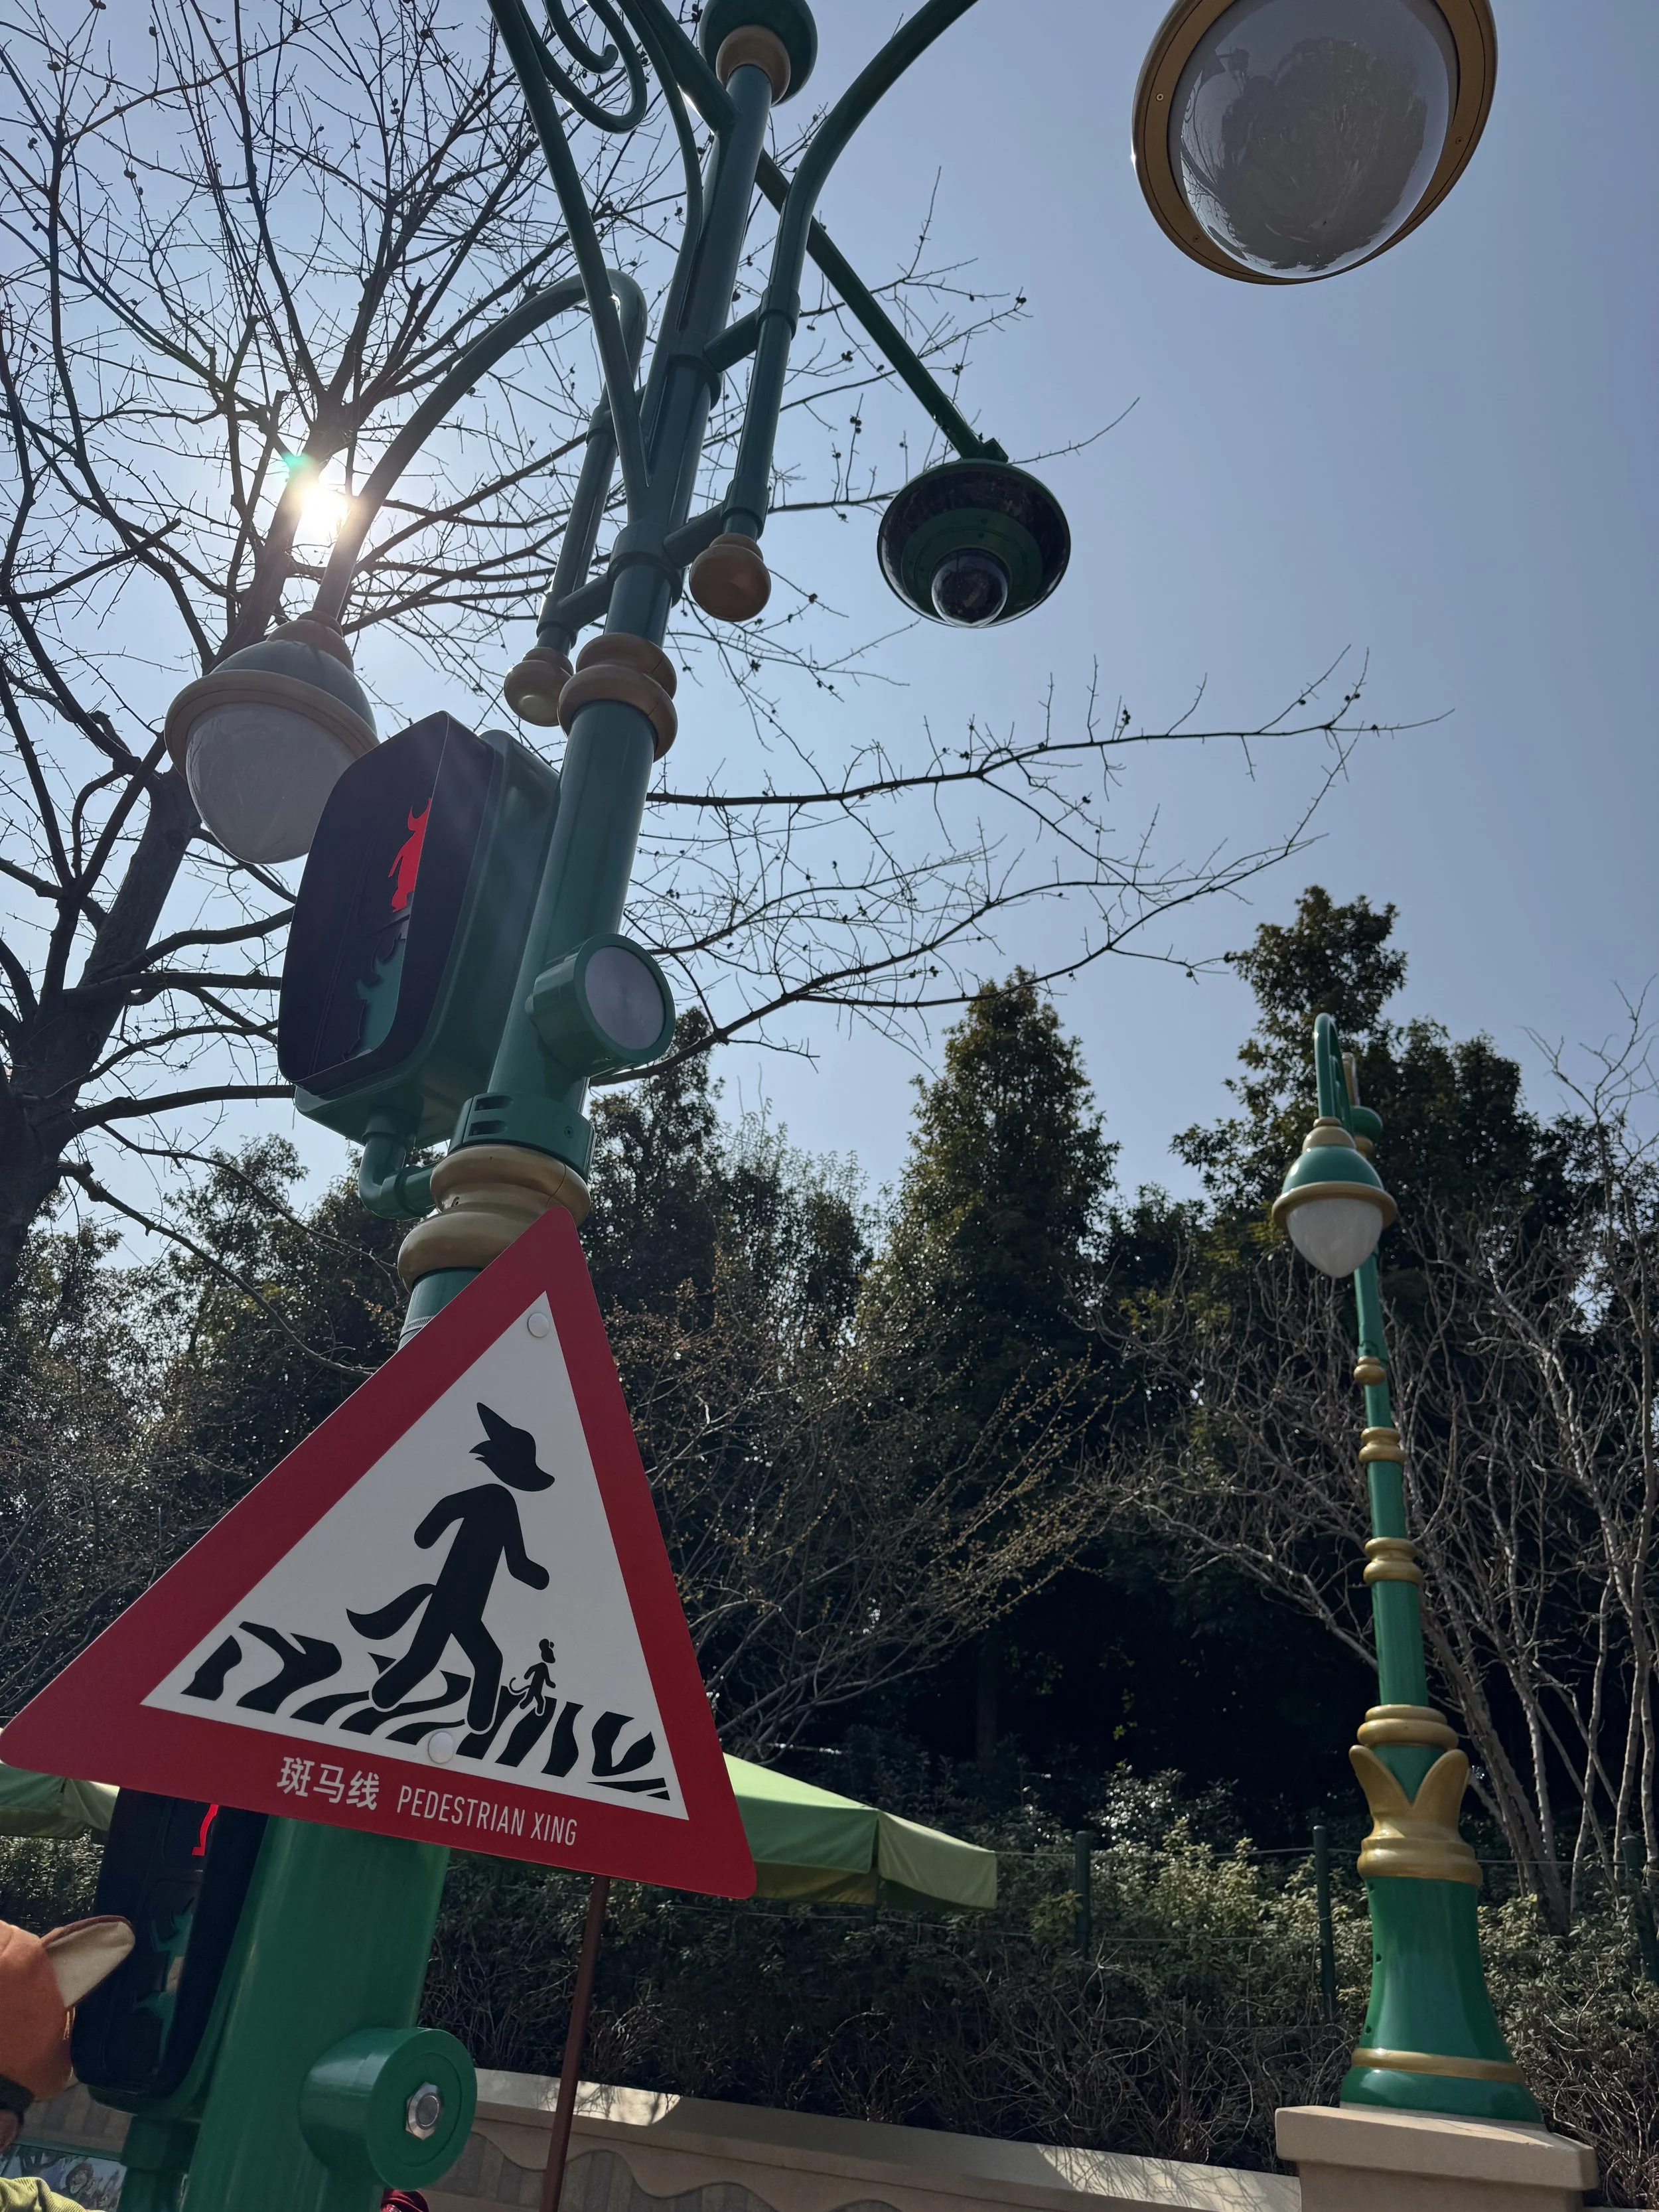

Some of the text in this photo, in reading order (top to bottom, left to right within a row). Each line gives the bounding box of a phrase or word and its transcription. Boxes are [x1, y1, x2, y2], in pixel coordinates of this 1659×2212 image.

[277, 1757, 380, 1810] 斑马线
[397, 1785, 577, 1846] PEDESTRIAN XING
